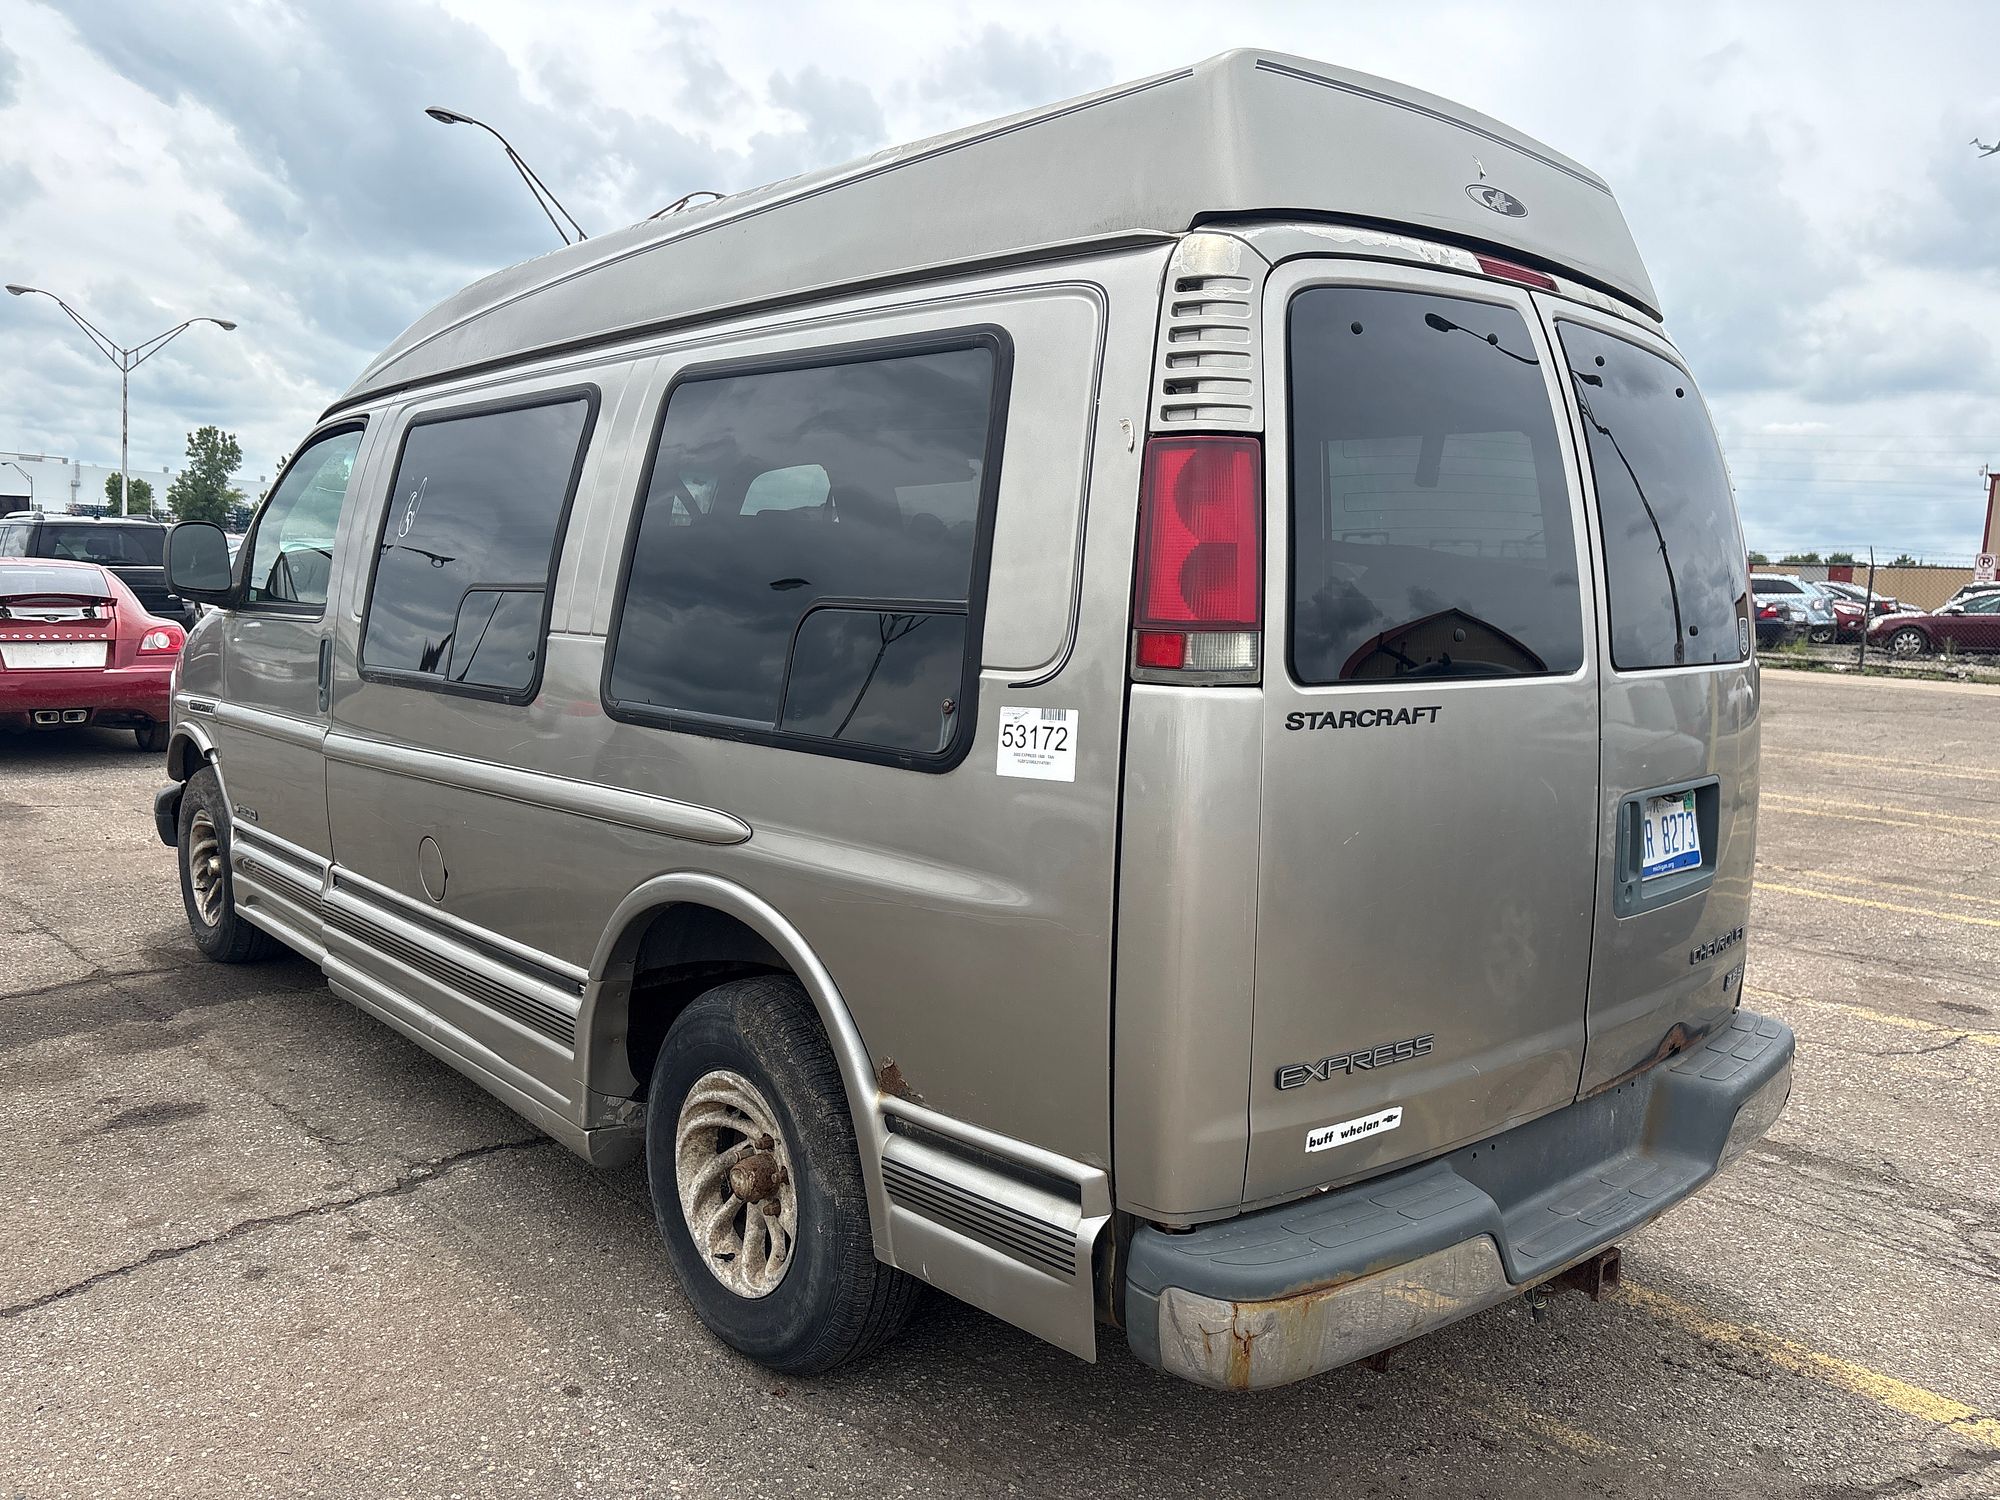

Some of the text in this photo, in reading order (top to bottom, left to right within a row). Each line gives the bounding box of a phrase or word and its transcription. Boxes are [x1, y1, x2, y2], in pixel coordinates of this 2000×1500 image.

[1285, 706, 1442, 731] STARCRAFT
[1002, 724, 1068, 752] 53172
[1643, 812, 1696, 859] R 8273
[1276, 1034, 1435, 1090] EXPRESS
[1309, 1119, 1380, 1148] buff whelan
